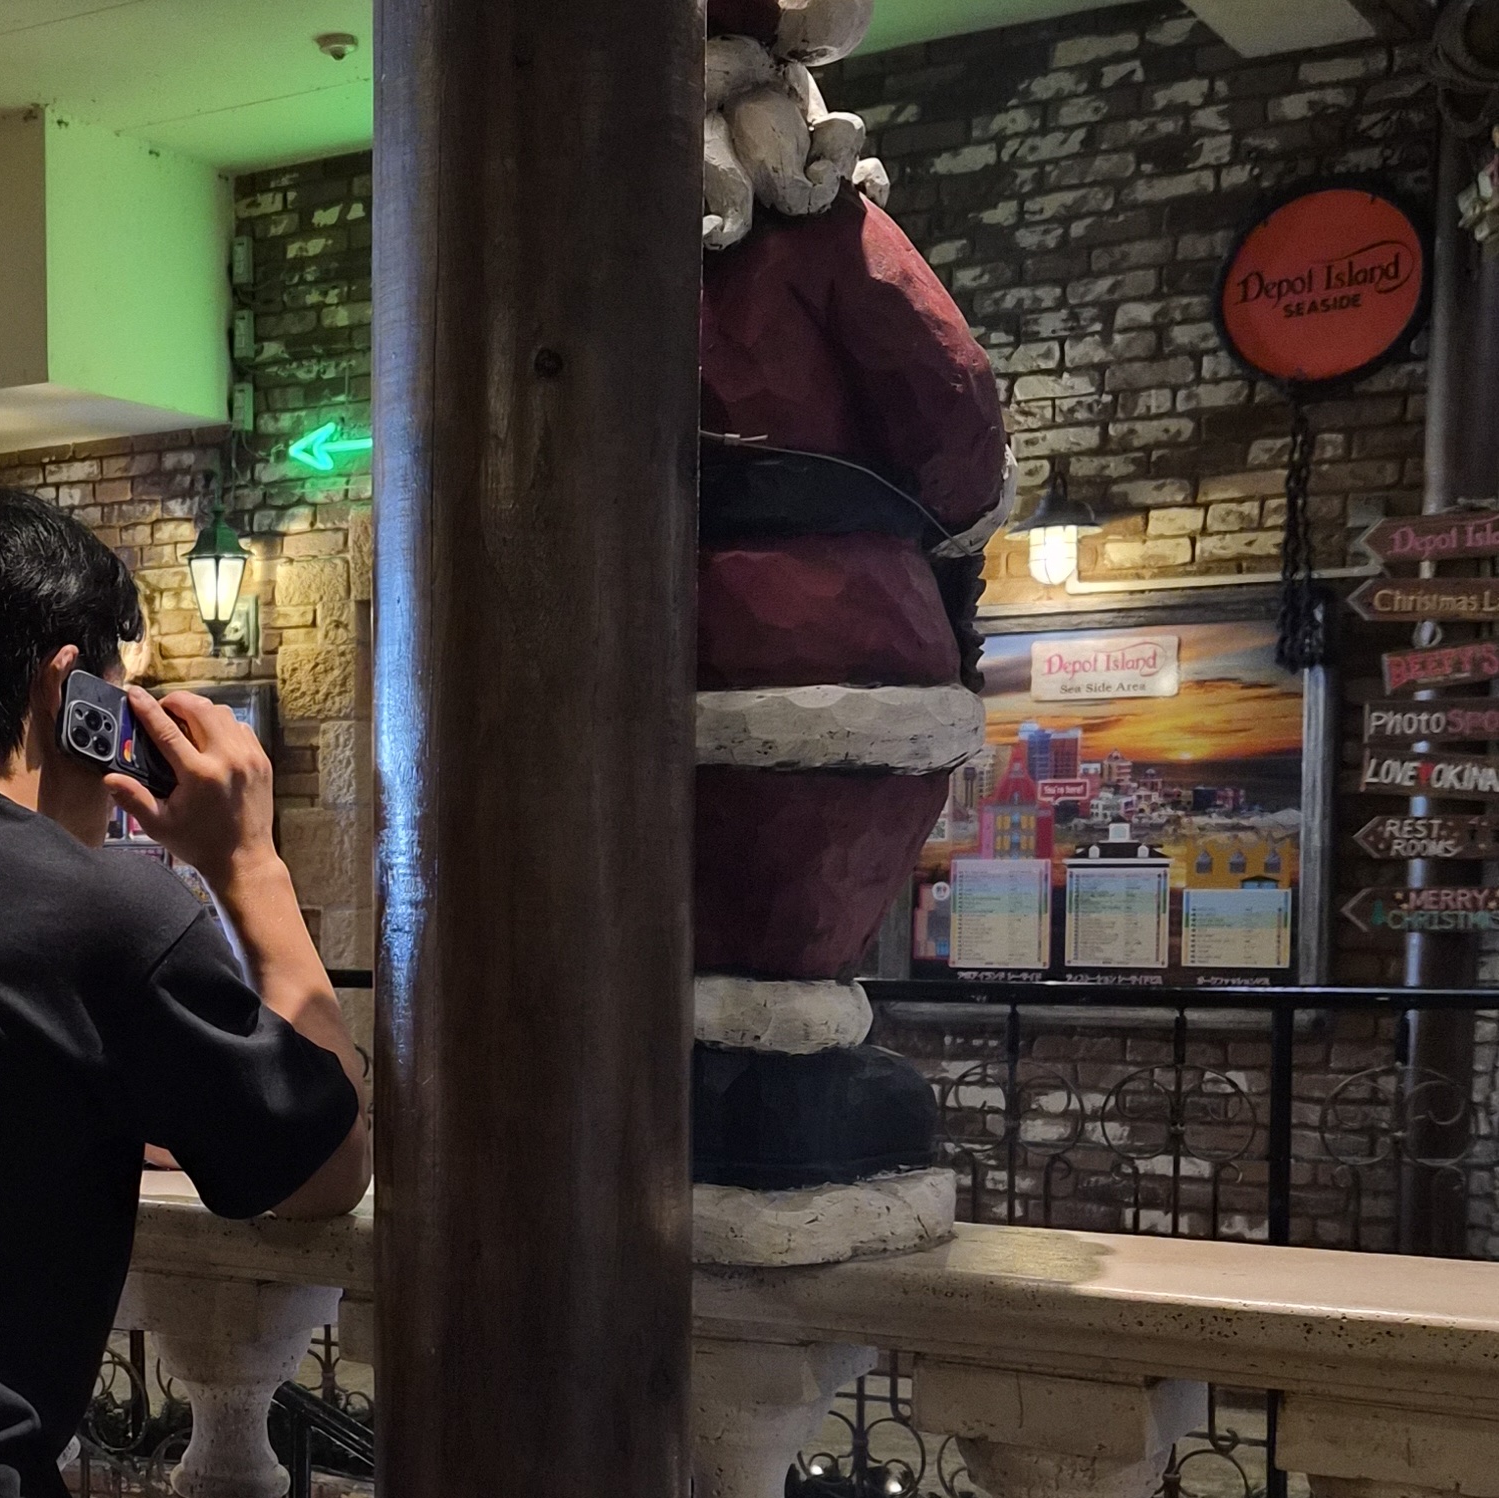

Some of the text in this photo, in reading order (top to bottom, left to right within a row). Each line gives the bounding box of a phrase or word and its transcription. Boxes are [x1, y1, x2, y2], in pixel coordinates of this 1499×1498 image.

[1234, 252, 1400, 309] Depot Island
[1283, 294, 1362, 318] SEASIDE
[1373, 589, 1478, 612] Christmas
[1042, 650, 1158, 680] Depot Island
[1060, 682, 1147, 694] Sea Side Area
[1365, 758, 1421, 786] LOVE
[1383, 819, 1443, 838] REST
[1390, 838, 1462, 857] ROOMS
[1408, 888, 1490, 910] MERRY
